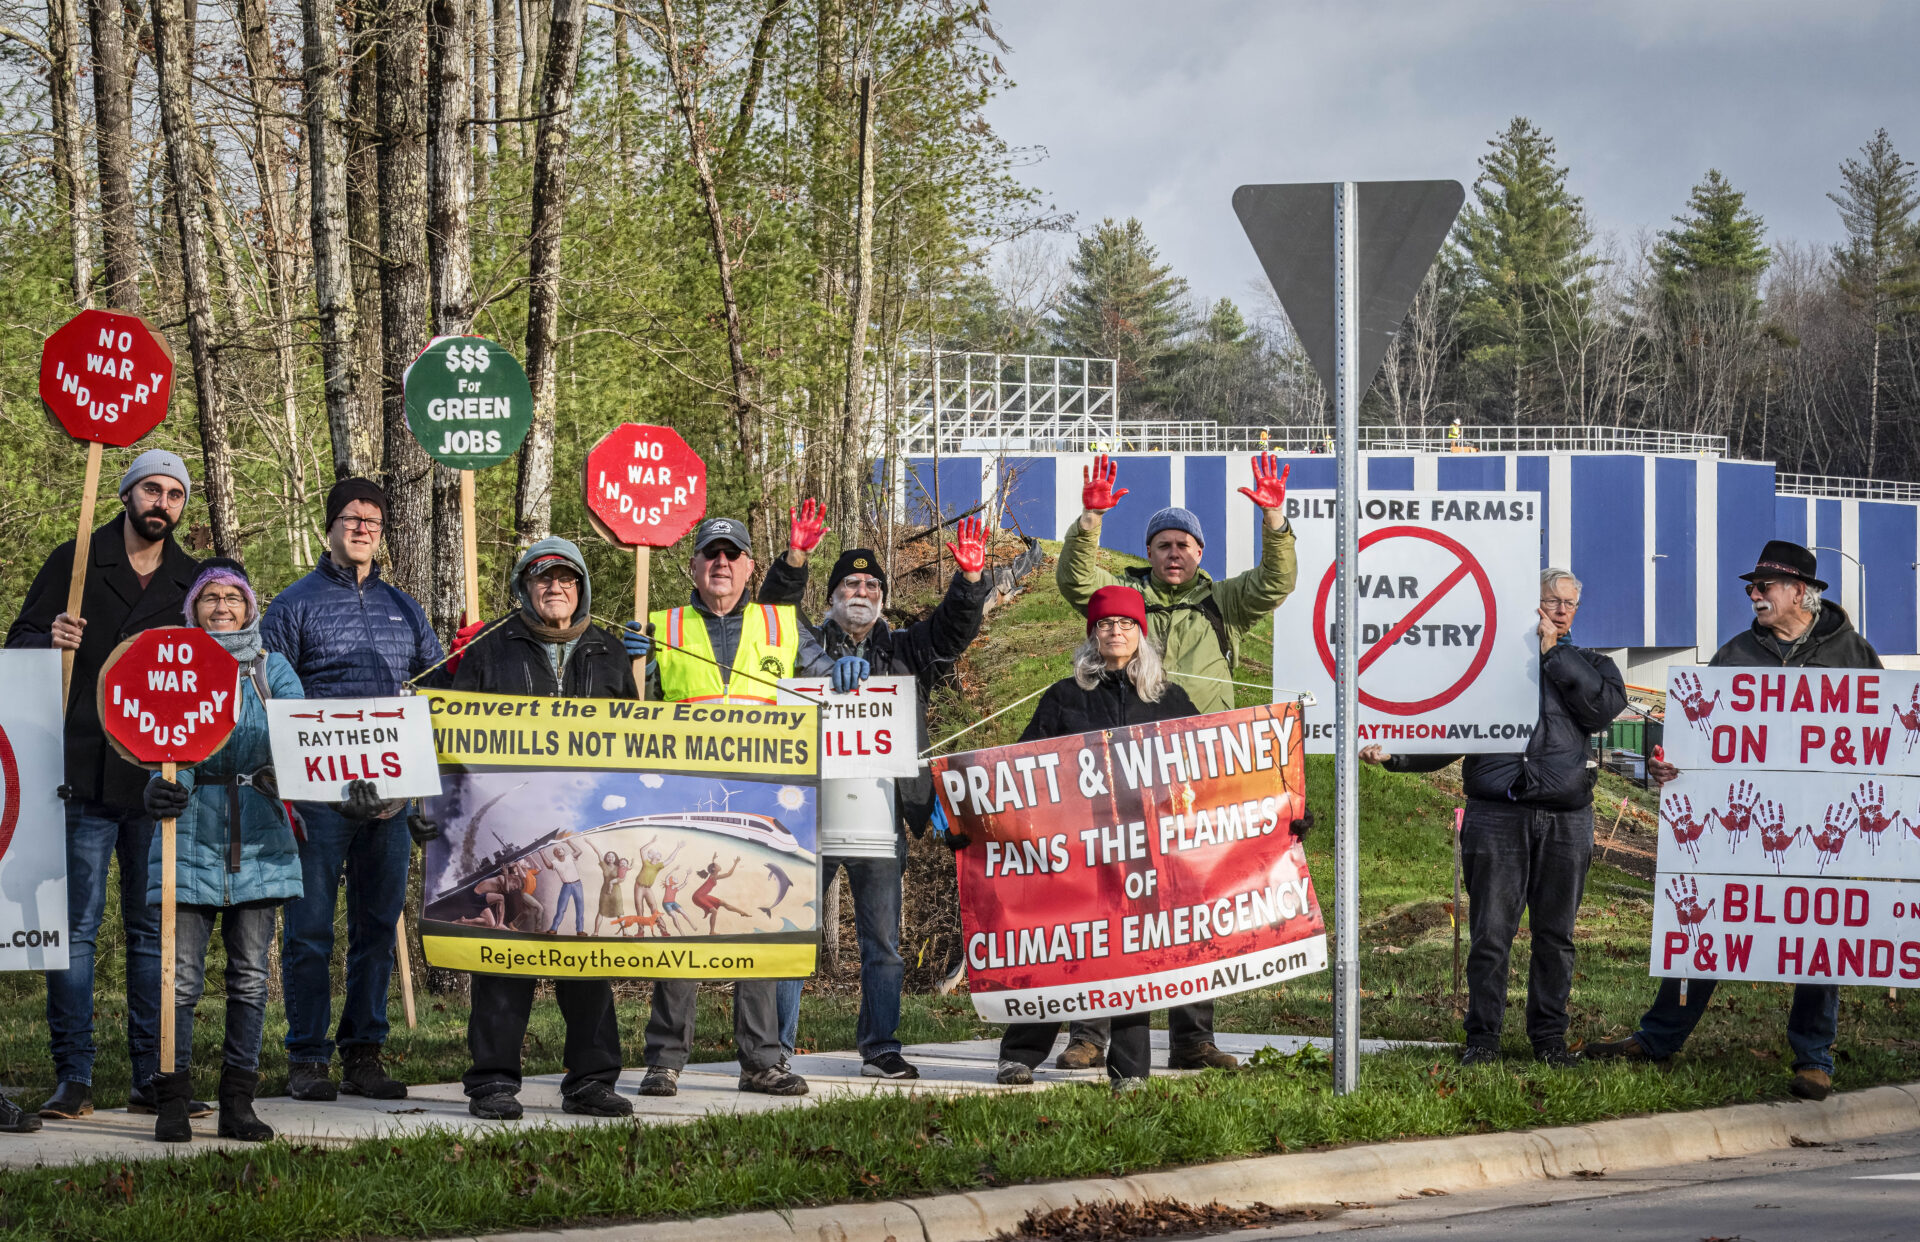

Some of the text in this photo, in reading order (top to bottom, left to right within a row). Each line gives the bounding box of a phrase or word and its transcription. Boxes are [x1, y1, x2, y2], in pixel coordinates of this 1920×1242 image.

[99, 328, 132, 353] NO
[86, 353, 134, 381] WAR
[445, 345, 490, 373] $$$
[56, 361, 163, 423] INDUSTRY
[427, 397, 511, 421] GREEN
[438, 430, 501, 455] JOBS
[634, 442, 663, 461] NO
[628, 465, 671, 485] WAR
[599, 472, 698, 526] INDUSTRY
[1286, 498, 1534, 522] BILTORE FARMS!
[1330, 622, 1482, 647] IDSTRY
[157, 644, 193, 665] NO
[147, 670, 197, 693] WAR
[1731, 673, 1879, 714] SHAME
[114, 686, 228, 746] INDUSTRY
[430, 697, 806, 730] Convert the War Economy
[828, 702, 893, 719] THEON
[299, 727, 399, 747] RAYTHEON
[826, 730, 892, 756] ILLS
[1303, 723, 1534, 740] JECAYTHEONAVL.COM
[1712, 725, 1891, 766] ON P&W
[434, 728, 808, 765] WINDMILLS NOT WAR MACHINES
[305, 751, 401, 782] KILLS
[942, 717, 1295, 816] PRATT & WHITNEY
[985, 797, 1278, 878] FANS THE FLAMES
[1125, 869, 1157, 900] OF
[1723, 883, 1920, 927] BLOOD ON
[969, 877, 1310, 970] CLIMATE EMERGENCY
[0, 930, 60, 948] .COM
[480, 946, 754, 972] RejectRaytheonAVL.com
[1664, 931, 1920, 979] P&W HANDS
[1005, 950, 1307, 1017] RejectRaytheonAVL.com
